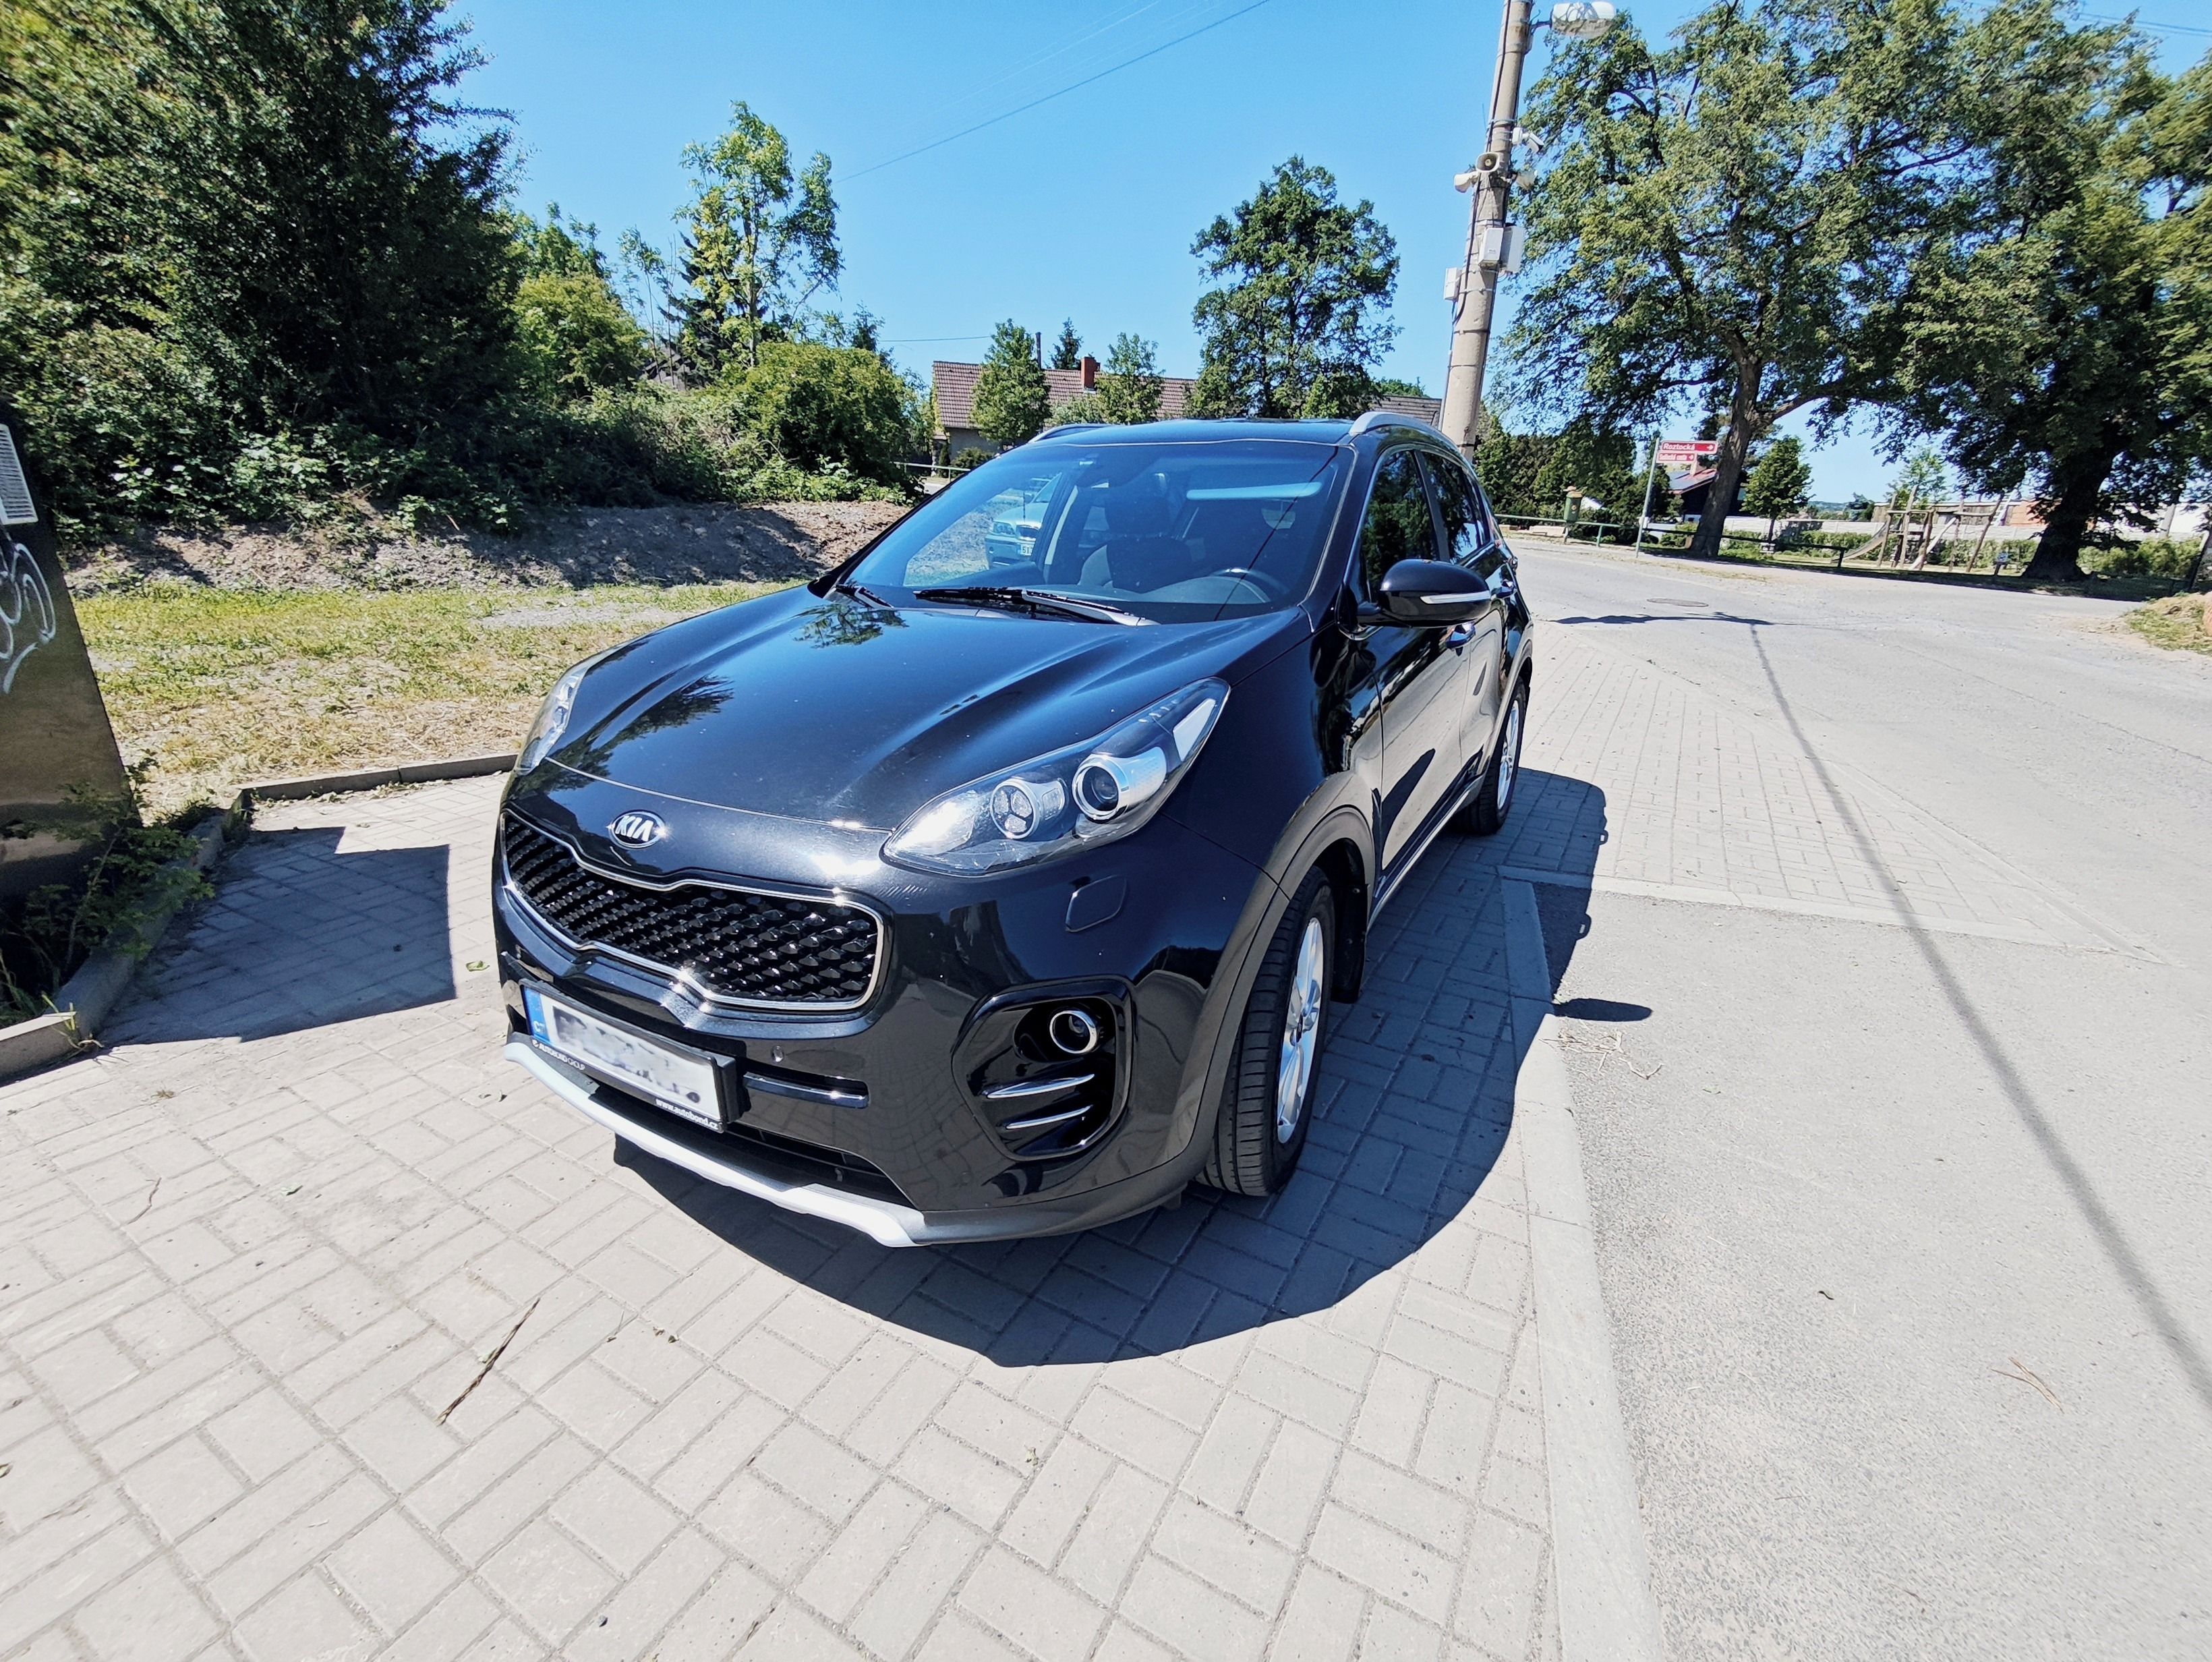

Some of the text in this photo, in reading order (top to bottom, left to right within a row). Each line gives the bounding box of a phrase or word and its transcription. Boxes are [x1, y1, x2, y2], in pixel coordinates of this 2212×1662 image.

[1663, 442, 1695, 451] Roztocká
[614, 815, 654, 842] KIA
[656, 1098, 719, 1130] www.autobond.cz
